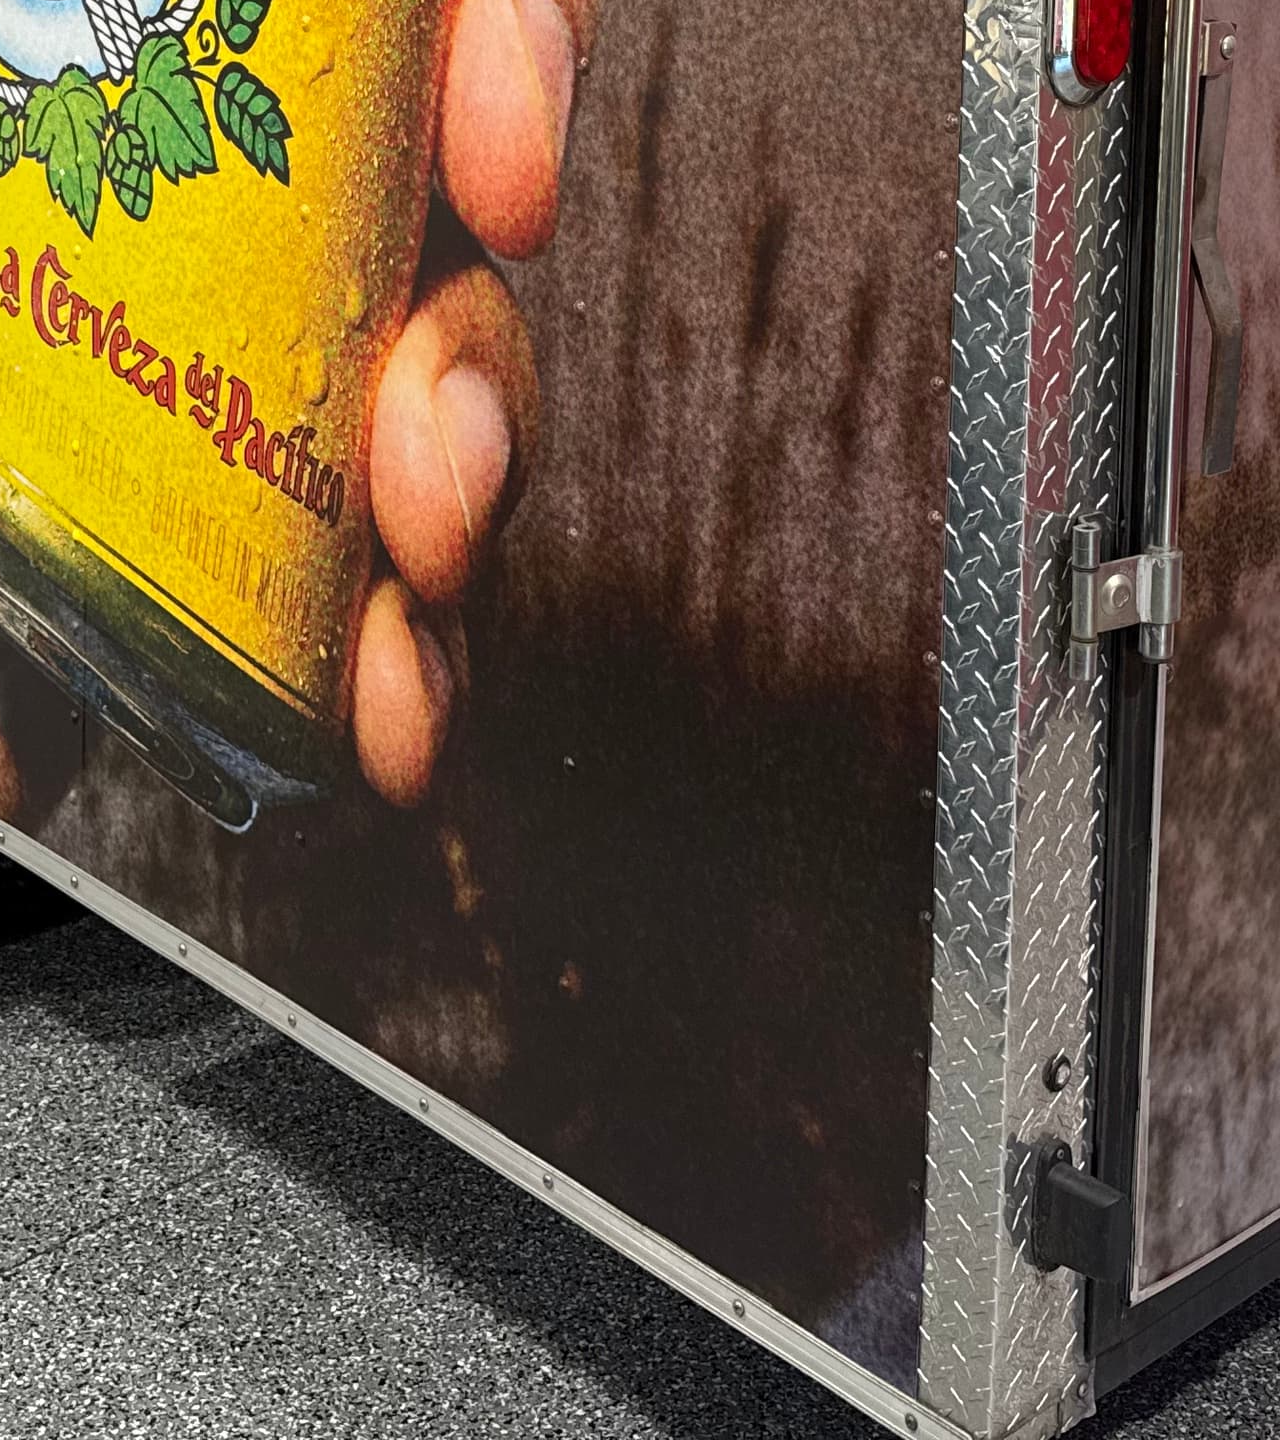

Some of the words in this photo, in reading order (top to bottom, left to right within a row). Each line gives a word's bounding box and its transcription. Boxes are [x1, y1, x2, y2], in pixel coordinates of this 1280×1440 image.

[31, 244, 177, 417] Cerveza
[185, 351, 224, 429] del
[213, 375, 345, 529] Pacífico
[151, 481, 227, 582] BREWED
[231, 535, 253, 603] IN
